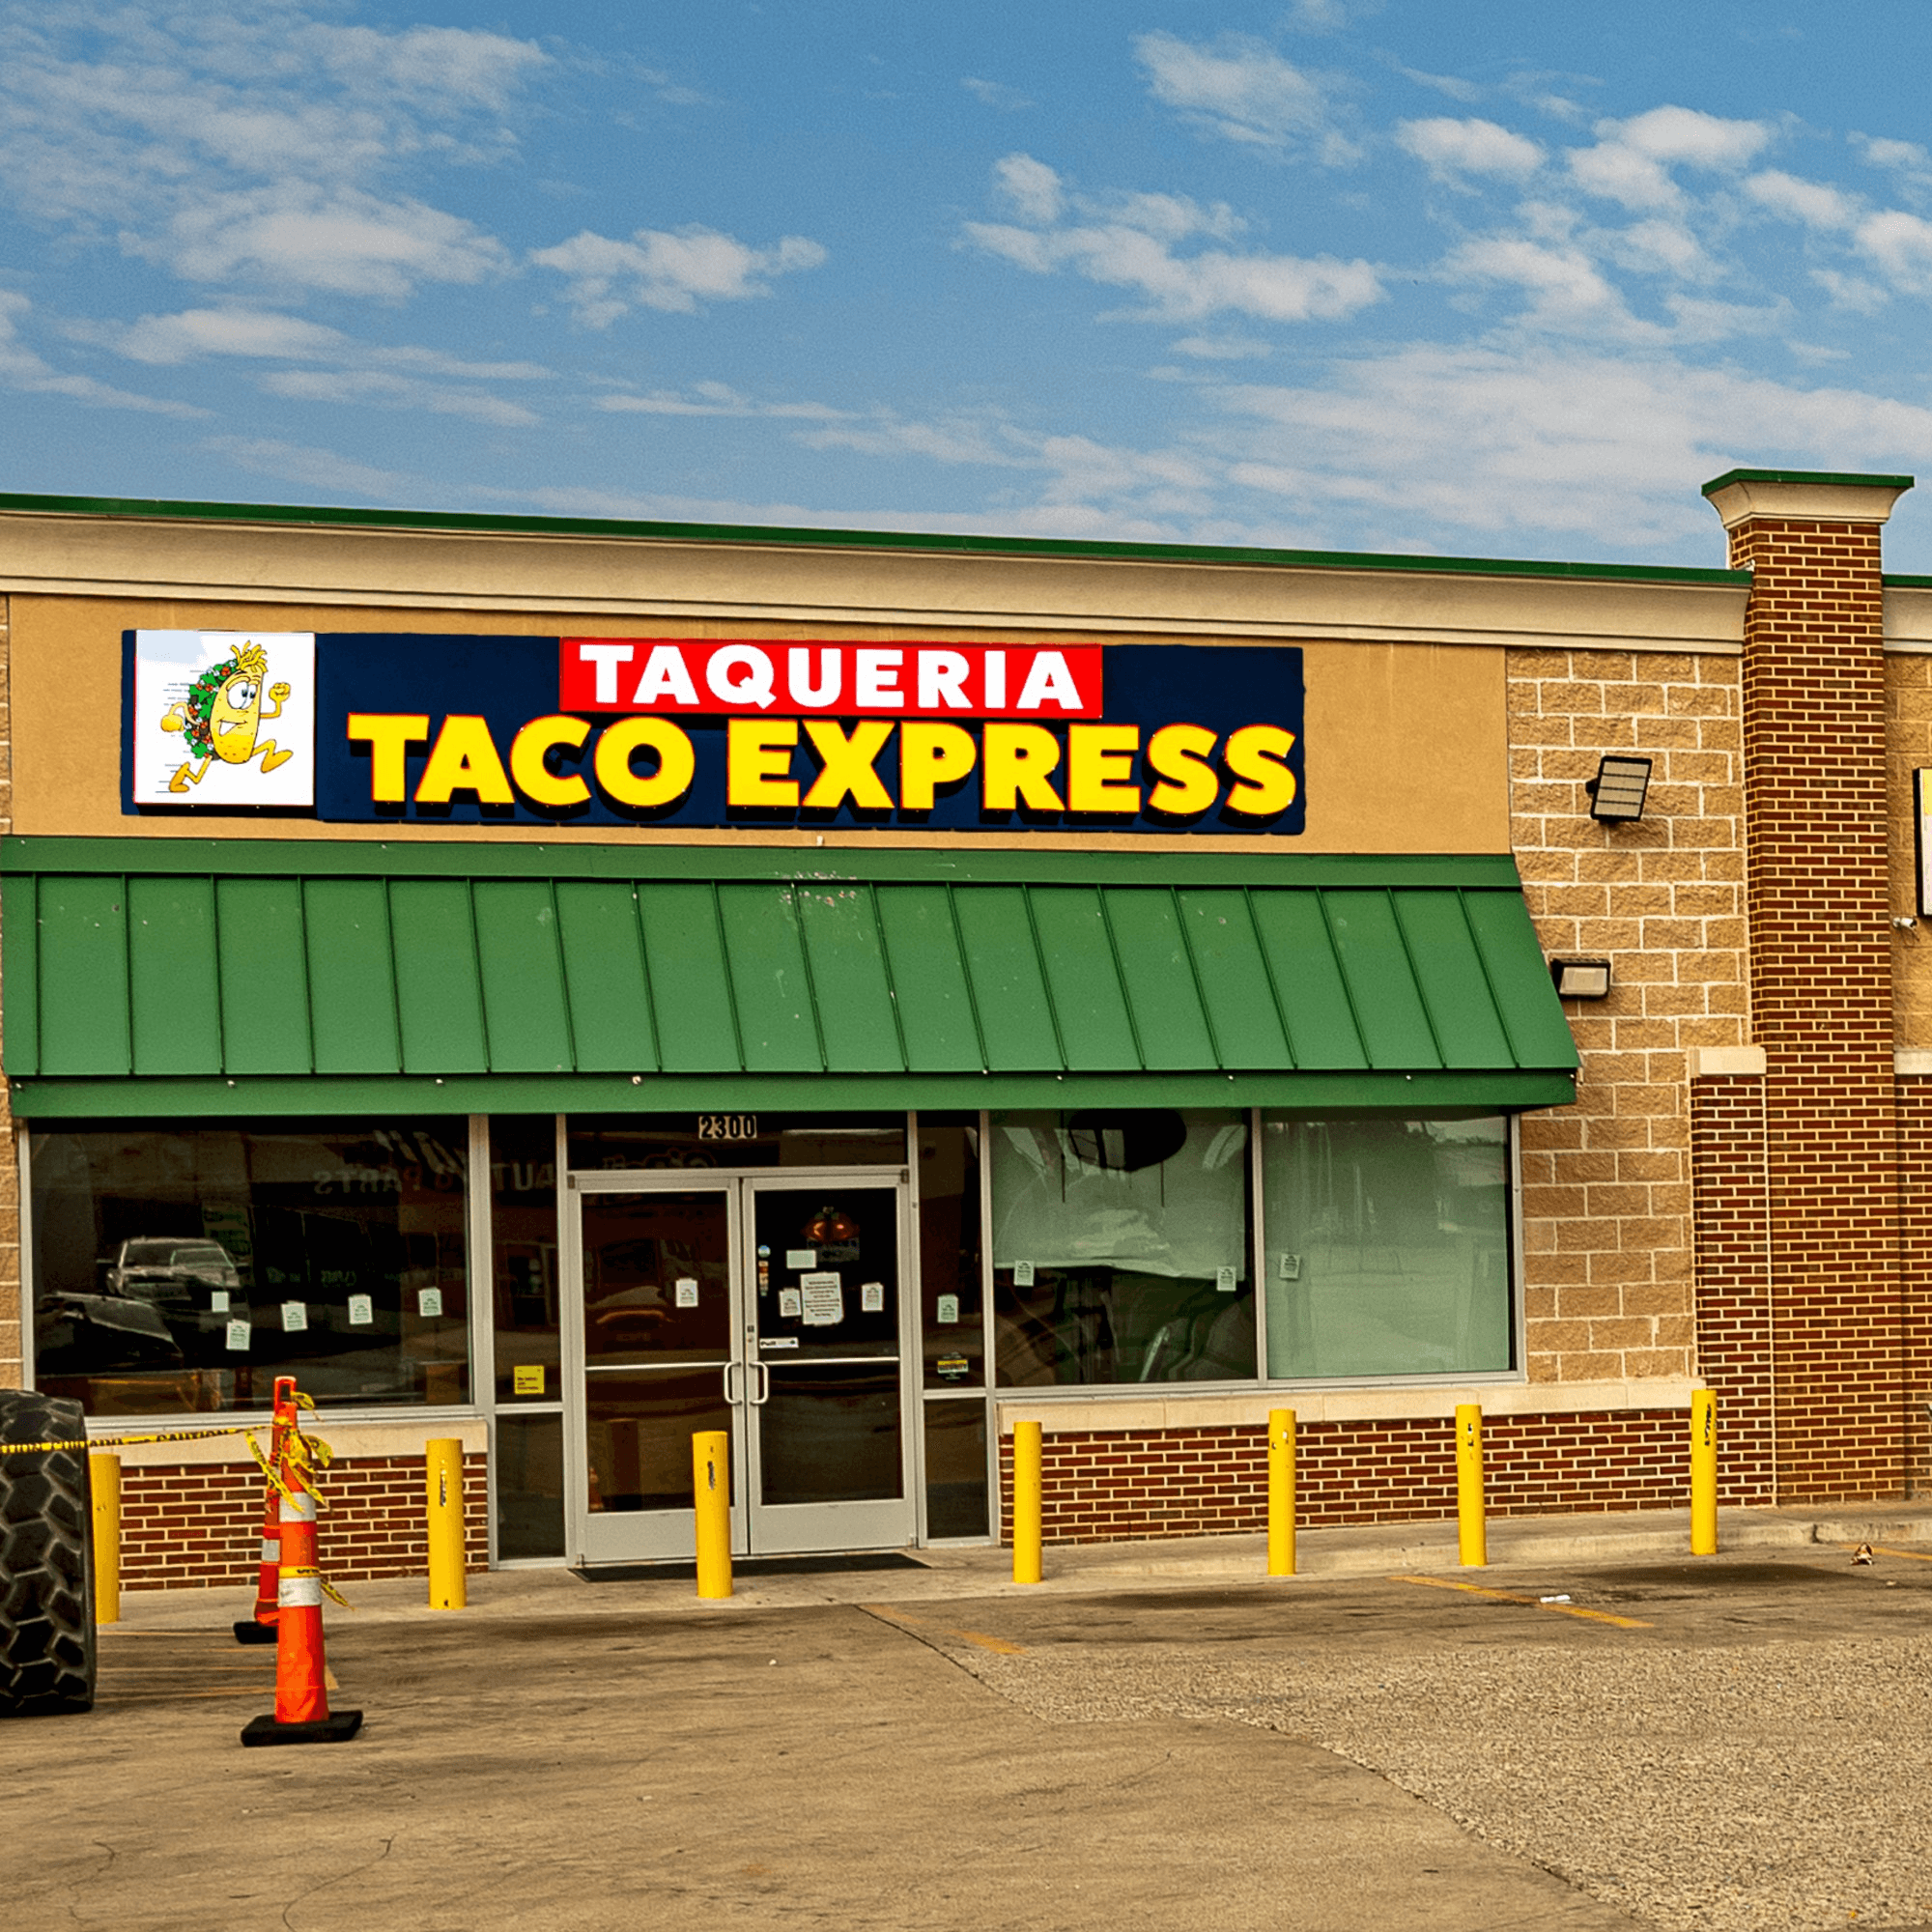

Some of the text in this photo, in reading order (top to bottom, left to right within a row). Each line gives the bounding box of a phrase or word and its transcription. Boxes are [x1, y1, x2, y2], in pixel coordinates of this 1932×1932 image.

[580, 644, 1084, 710] TAQUERIA
[347, 713, 1296, 816] TACO EXPRESS
[700, 1116, 755, 1138] 2300
